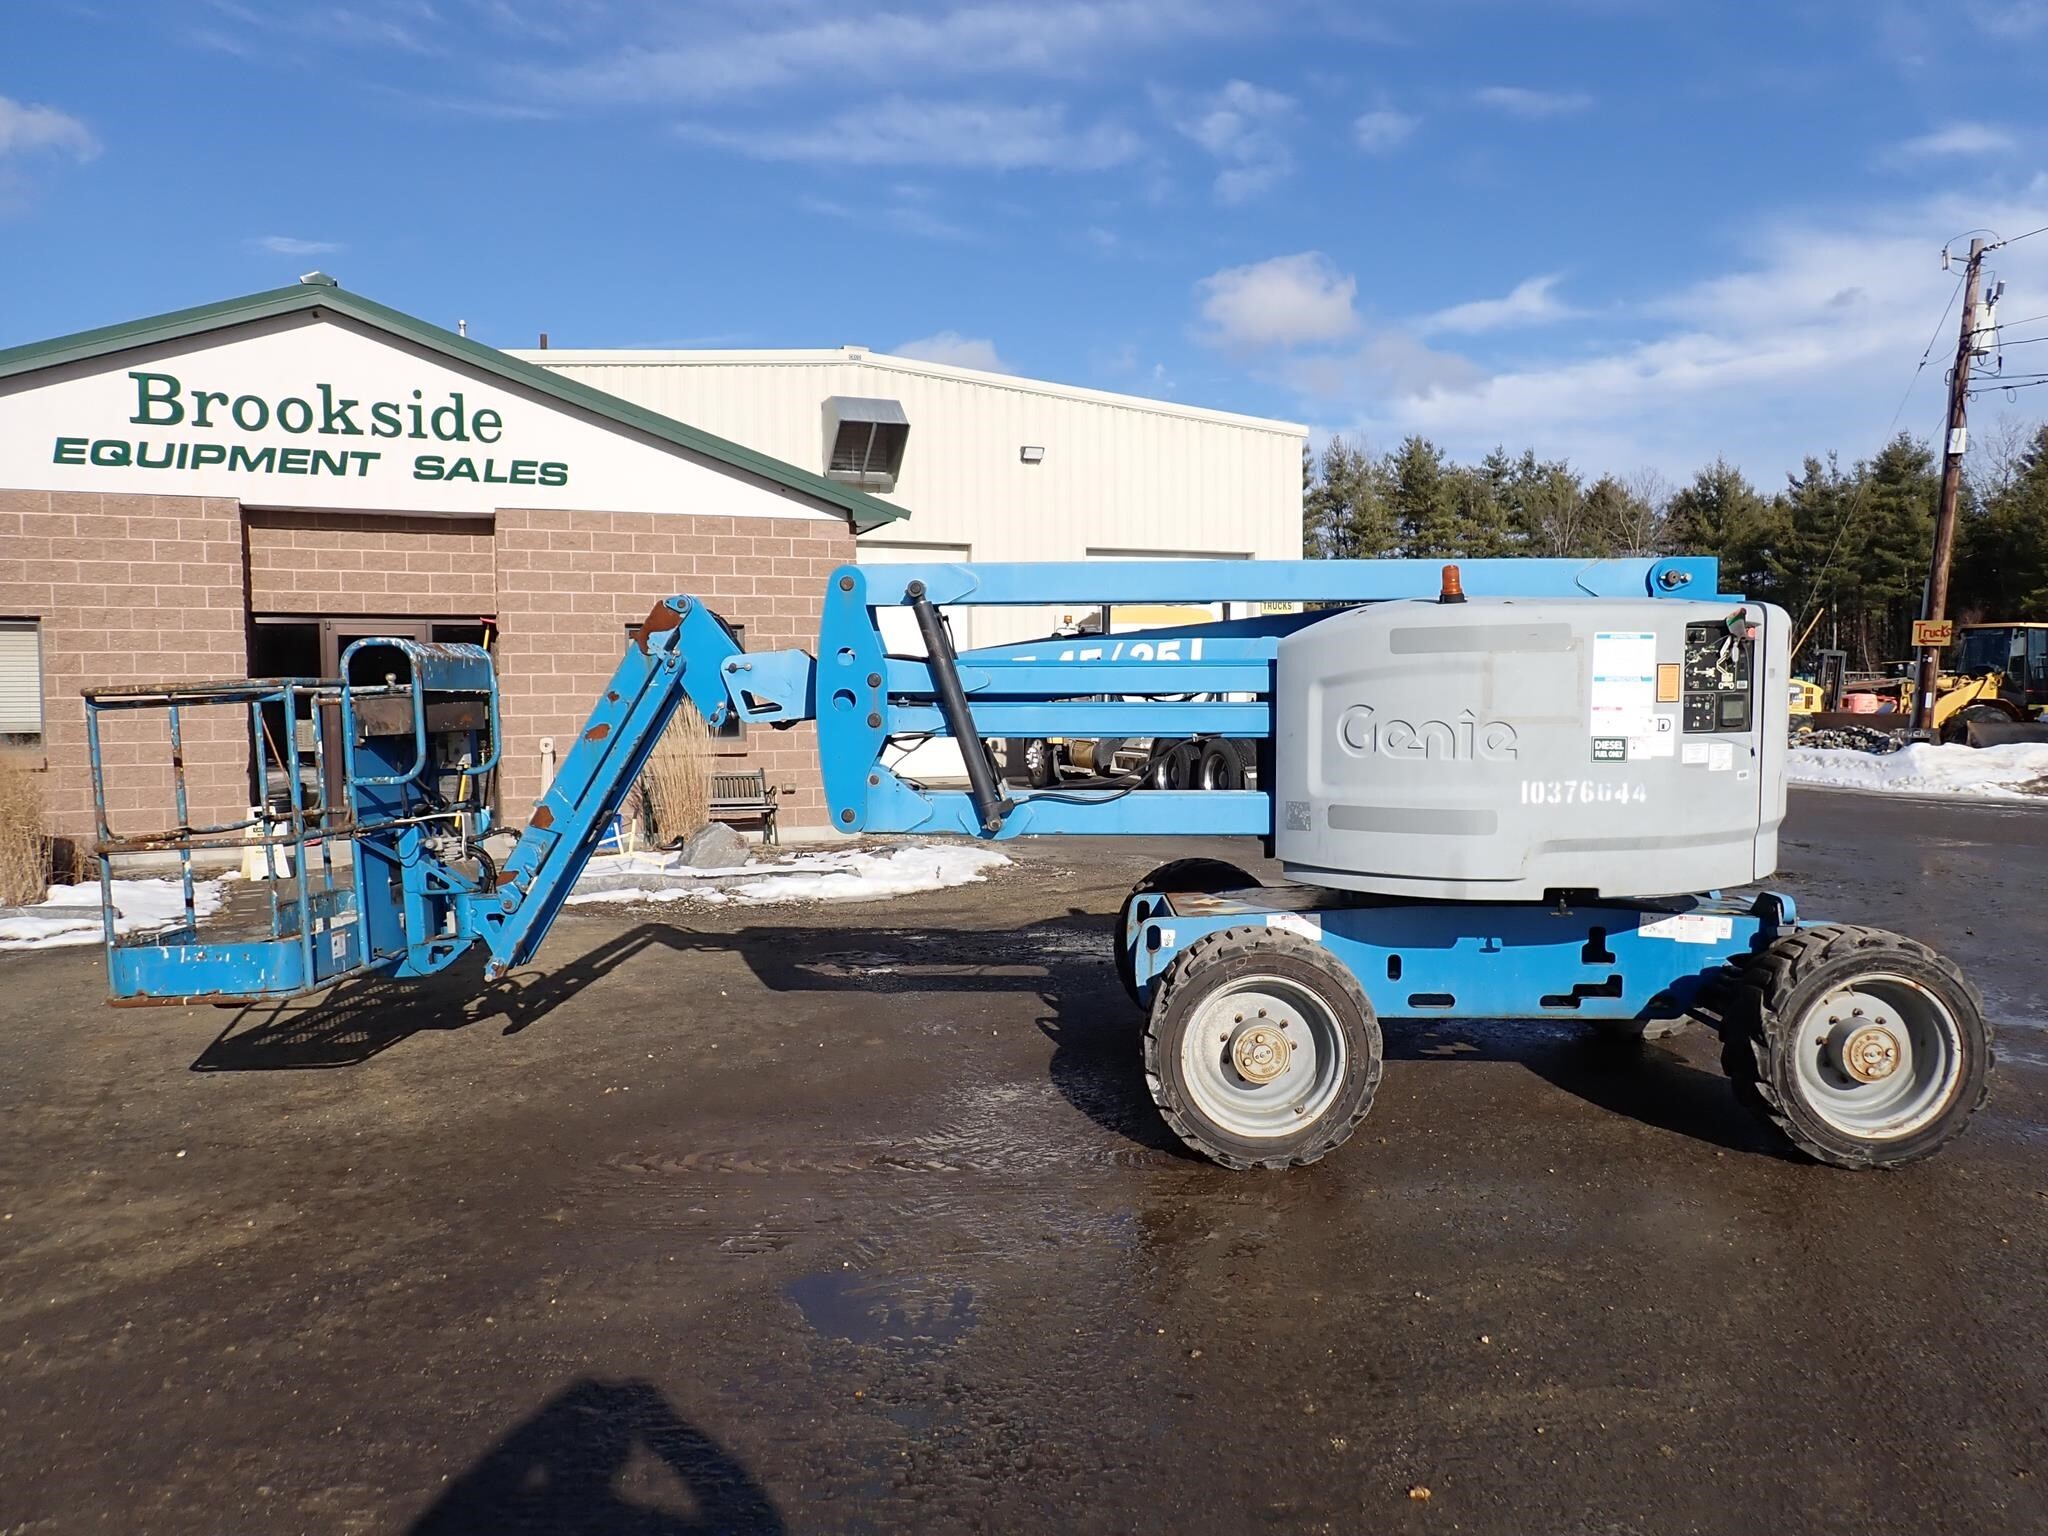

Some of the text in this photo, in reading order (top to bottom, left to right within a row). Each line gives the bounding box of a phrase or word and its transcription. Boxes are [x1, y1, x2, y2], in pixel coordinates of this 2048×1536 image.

[129, 372, 502, 443] Brookside
[53, 437, 568, 487] EQUIPMENT SALES
[1263, 601, 1292, 610] TRUCKS
[1915, 623, 1952, 639] Trucks
[1336, 704, 1518, 760] Genie
[1595, 740, 1624, 750] DIESEL
